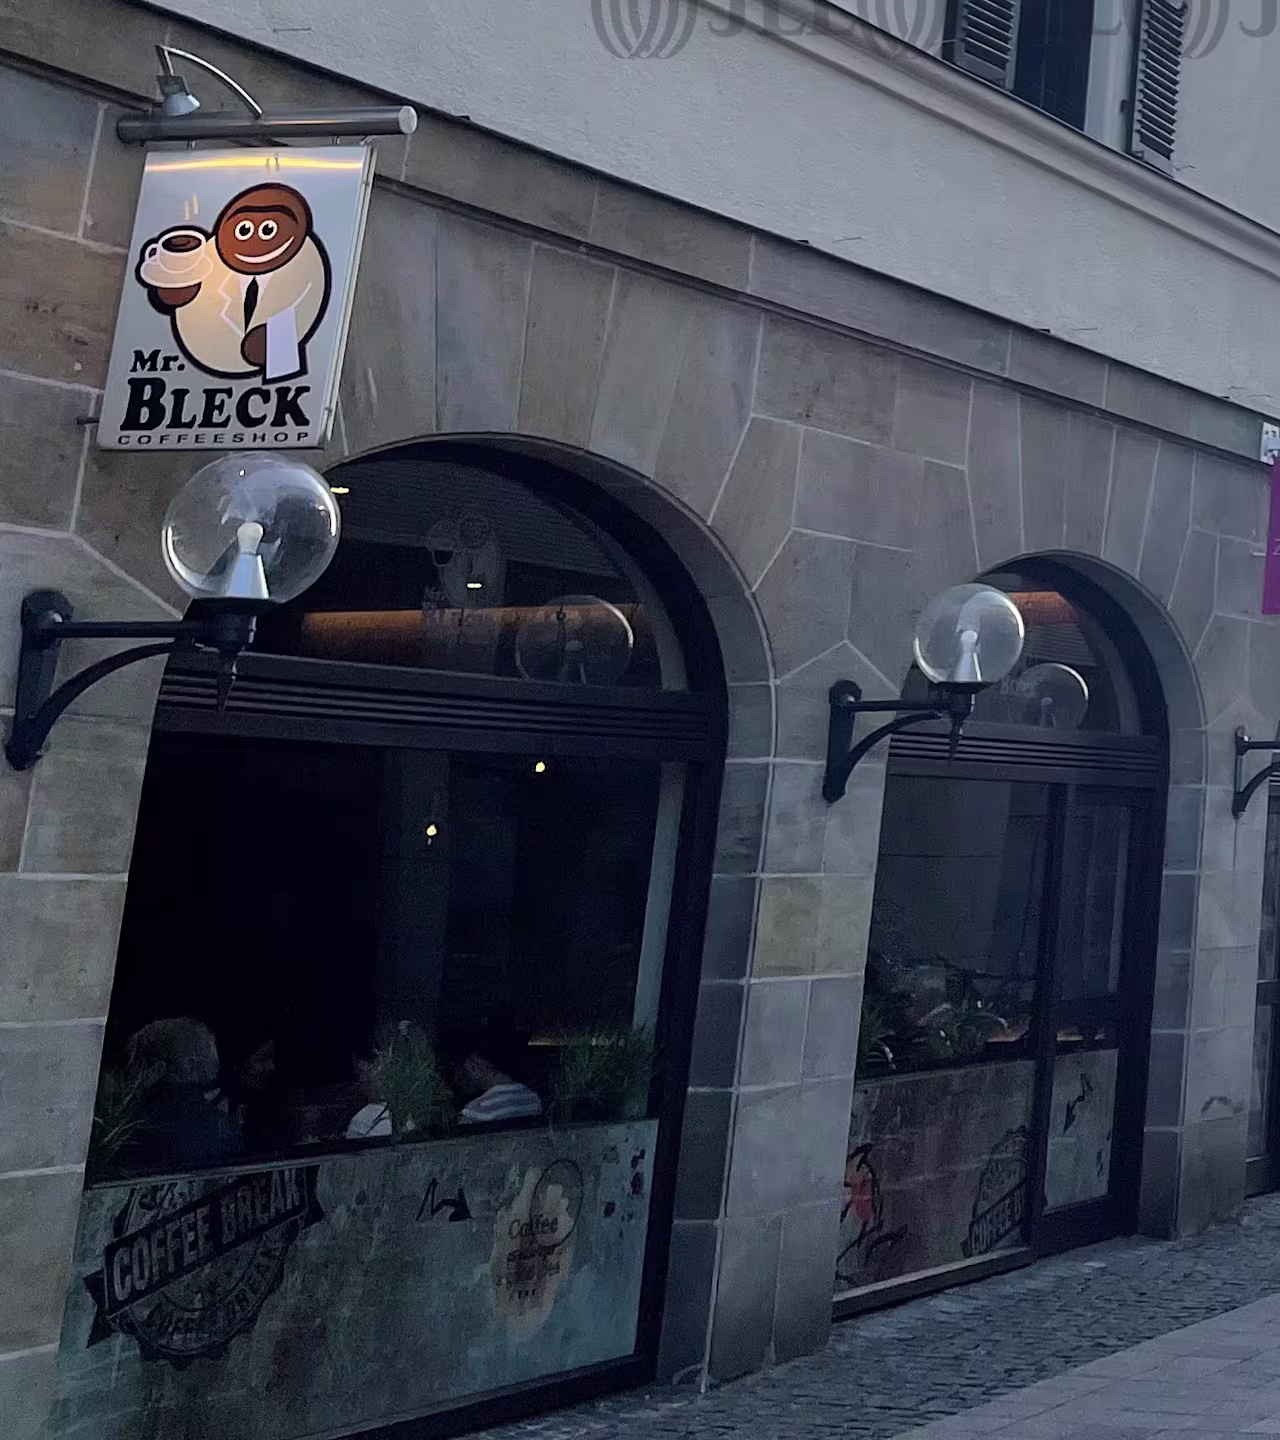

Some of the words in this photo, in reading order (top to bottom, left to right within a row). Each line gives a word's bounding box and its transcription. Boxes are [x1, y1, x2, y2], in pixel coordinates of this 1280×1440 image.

[129, 349, 186, 372] Mr.
[119, 377, 311, 431] BLECK
[117, 432, 309, 445] COFFEESHOP
[112, 1203, 212, 1301] COFFEE
